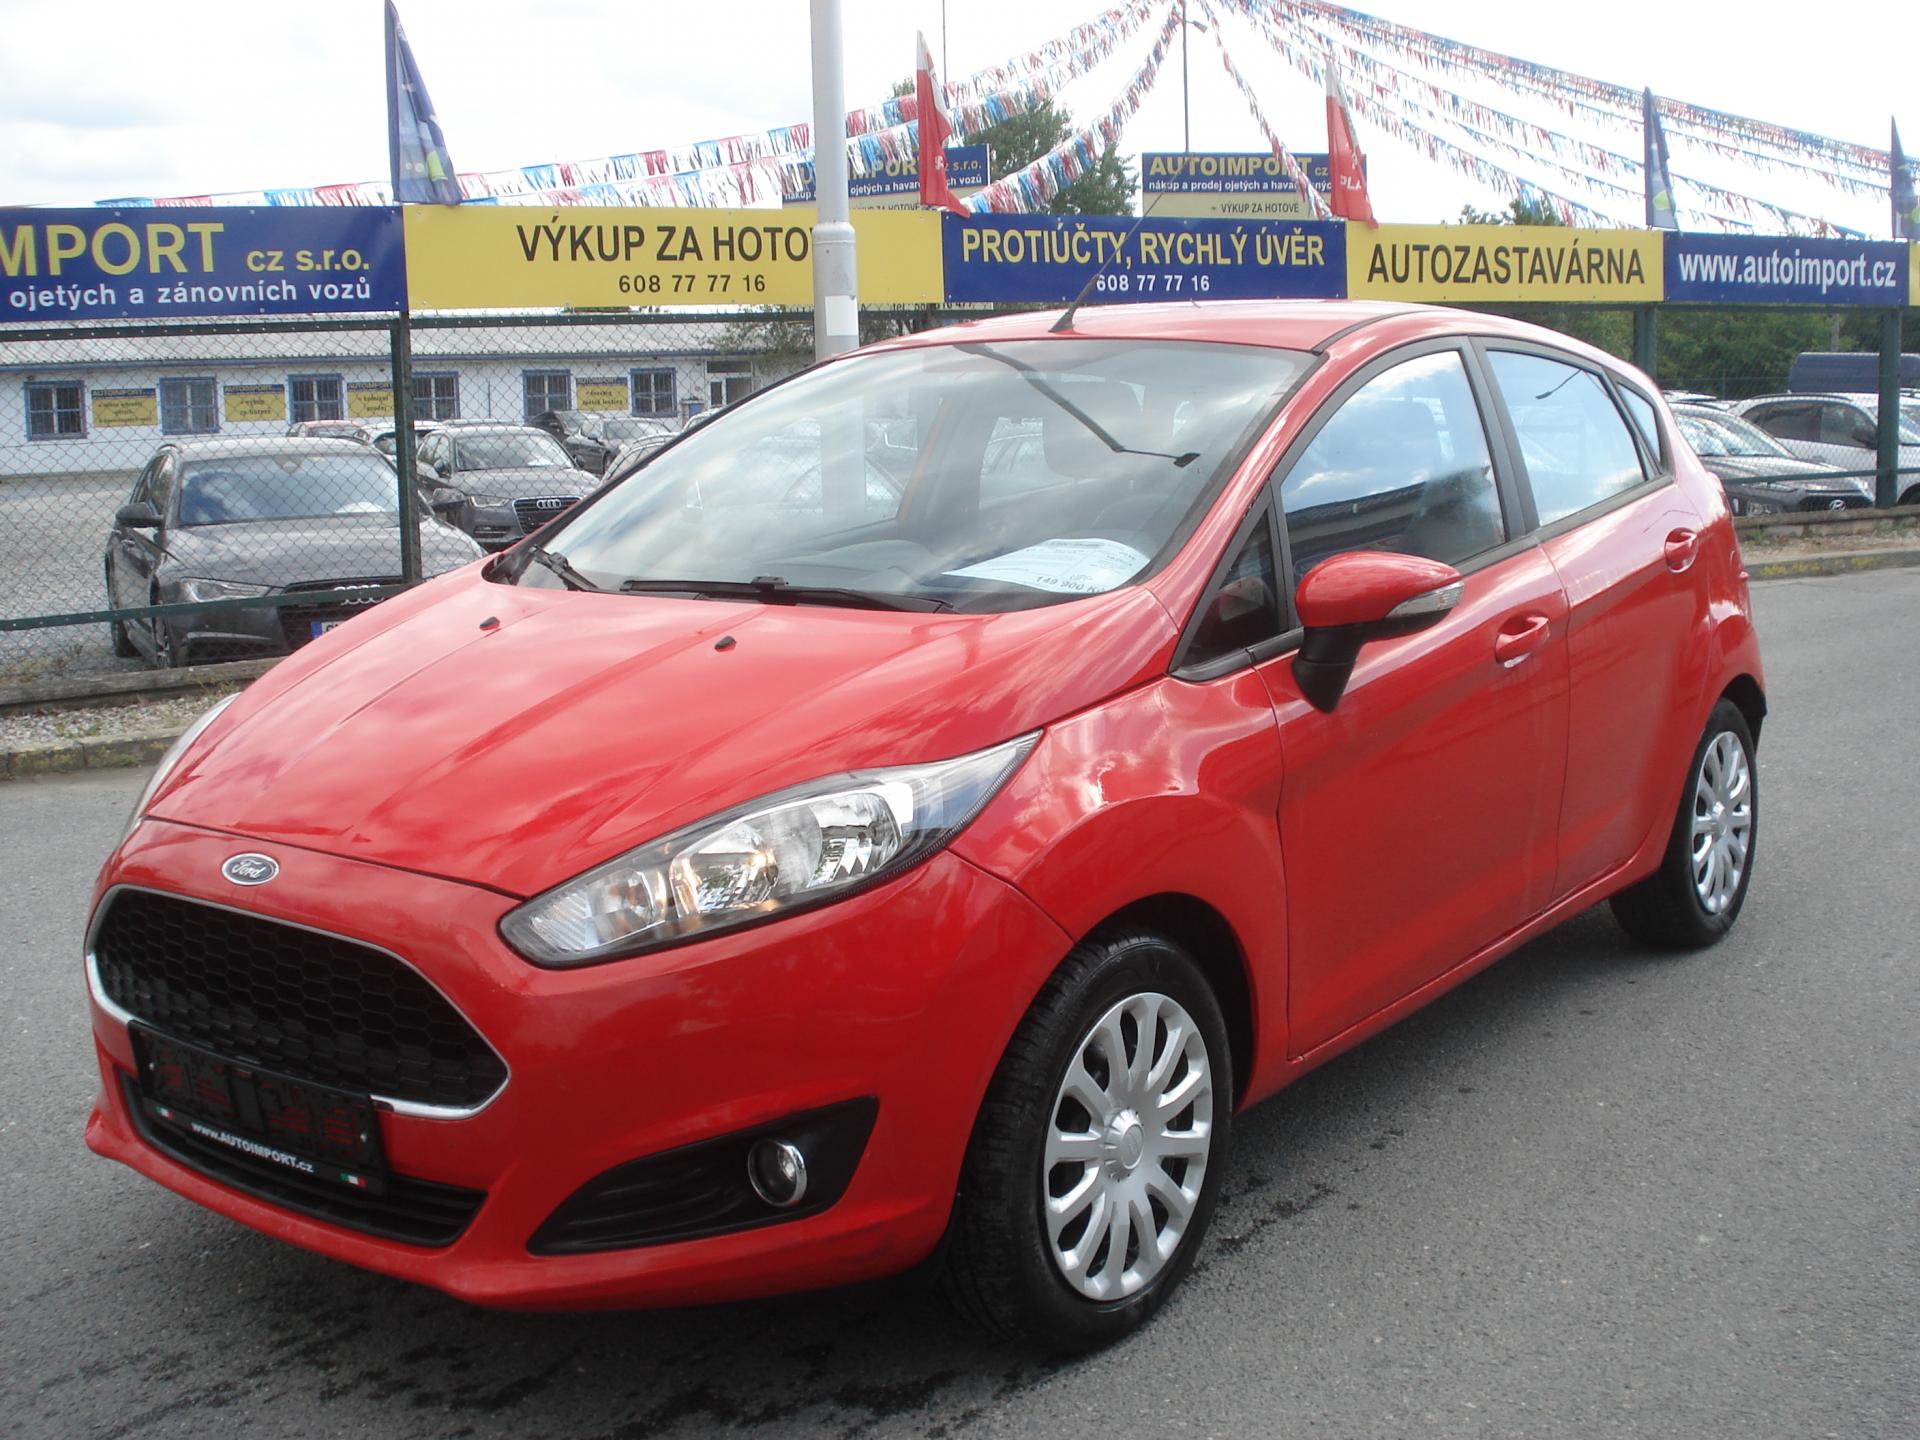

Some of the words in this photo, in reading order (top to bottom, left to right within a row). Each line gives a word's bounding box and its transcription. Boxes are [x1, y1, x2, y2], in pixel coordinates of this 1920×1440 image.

[953, 160, 982, 171] s.r.o.
[1314, 166, 1329, 177] cz
[850, 179, 882, 196] ojetých
[885, 182, 891, 192] a
[959, 174, 982, 184] vozů
[1149, 179, 1180, 191] nákup
[1182, 182, 1188, 190] a
[1191, 180, 1222, 192] prodej
[1225, 180, 1260, 192] ojetých
[1262, 182, 1269, 190] a
[1251, 202, 1263, 213] ZA
[516, 215, 645, 261] VÝKUP
[656, 225, 703, 261] ZA
[713, 225, 813, 262] HOTO
[962, 222, 1132, 270] PROTIÚČTY,
[1139, 225, 1249, 265] RYCHLÝ
[1255, 226, 1325, 266] ÚVĚR
[246, 249, 285, 273] cz
[296, 248, 370, 272] s.r.o.
[1367, 237, 1646, 285] AUTOZASTAVÁRNA
[1678, 248, 1897, 295] www.autoimport.cz
[9, 282, 116, 312] ojetých
[129, 286, 144, 304] a
[157, 279, 297, 304] zánovních
[308, 276, 371, 300] vozů
[619, 274, 661, 293] 608
[672, 274, 696, 292] 77
[707, 274, 731, 292] 77
[742, 273, 766, 292] 16
[1096, 274, 1129, 292] 608
[1136, 274, 1156, 292] 77
[1164, 274, 1183, 292] 77
[1191, 275, 1210, 292] 16
[231, 858, 266, 879] Ford
[191, 1121, 315, 1173] www.AUTOIMPORT.cz
